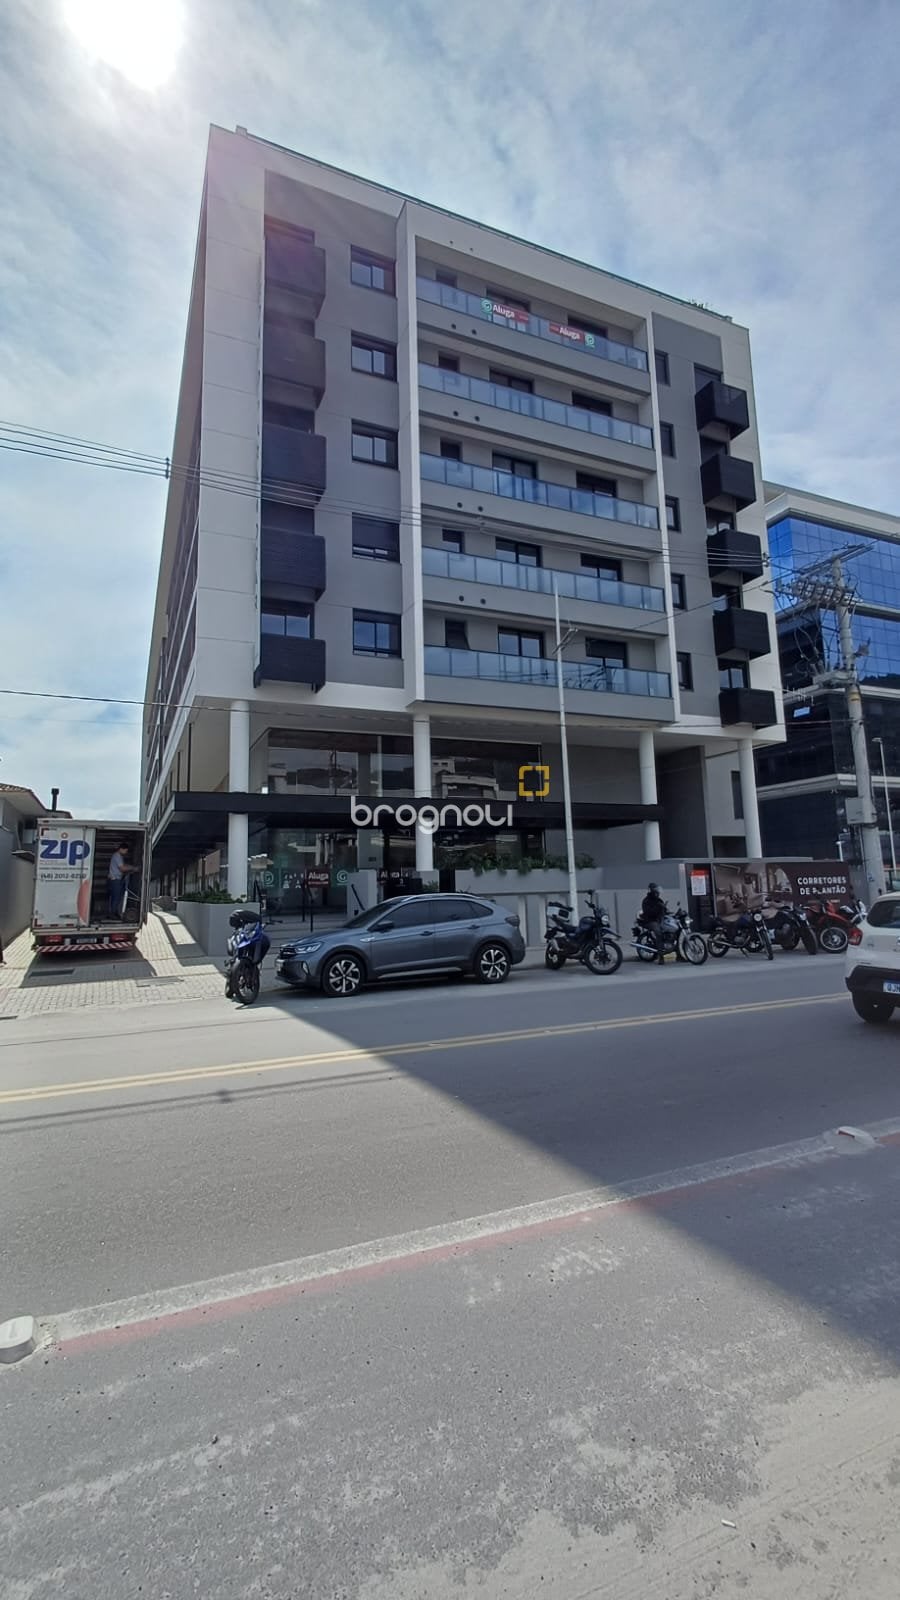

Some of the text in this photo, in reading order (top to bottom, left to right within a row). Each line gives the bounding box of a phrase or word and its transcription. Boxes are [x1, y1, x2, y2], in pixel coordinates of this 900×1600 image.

[493, 304, 515, 318] Aluga
[560, 327, 580, 340] Aluga
[40, 832, 90, 866] zip
[308, 872, 329, 880] Aluga
[797, 876, 847, 885] CORRETORES
[800, 887, 810, 895] DE
